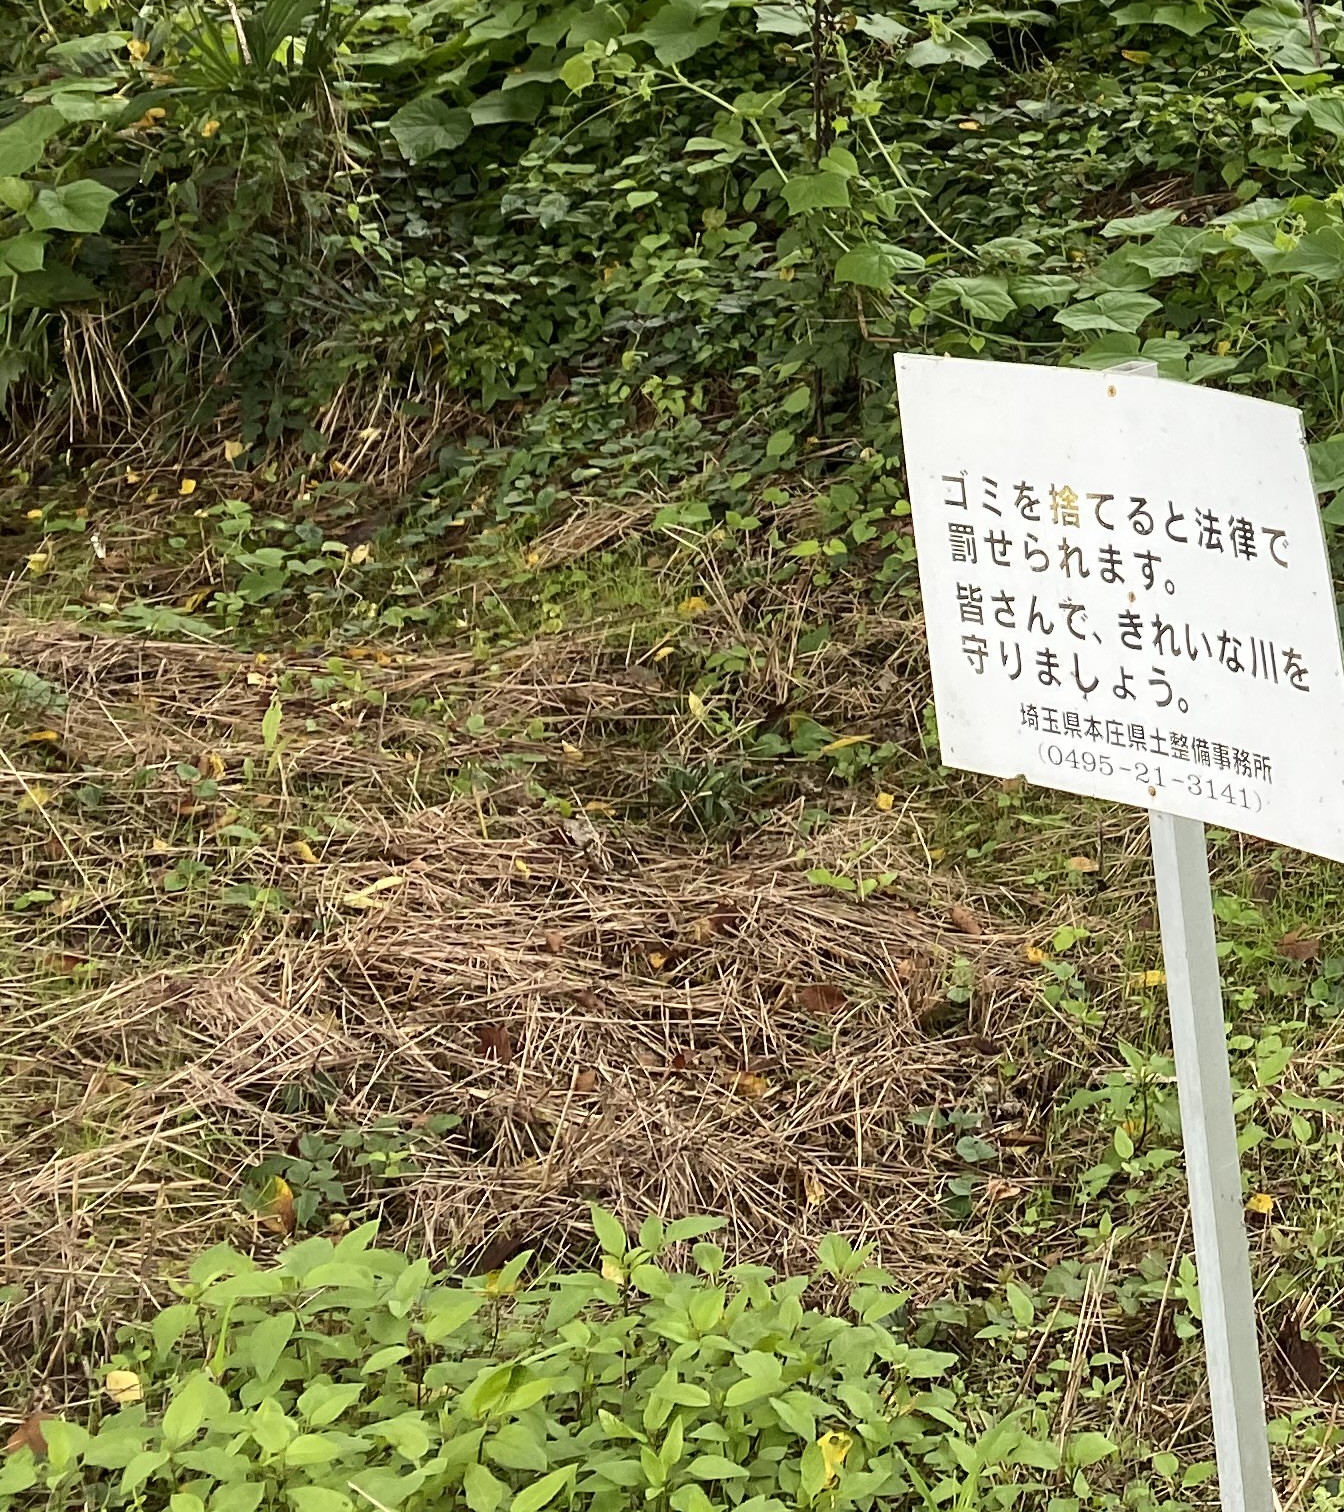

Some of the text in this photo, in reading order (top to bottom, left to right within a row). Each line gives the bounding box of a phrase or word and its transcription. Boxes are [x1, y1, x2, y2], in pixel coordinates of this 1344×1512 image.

[941, 469, 1289, 569] ゴミを捨てると法律で
[948, 522, 1175, 595] 罰せられます。
[956, 581, 1310, 692] 皆さんで、きれいな川を
[961, 634, 1189, 713] 守りましょう。
[1020, 702, 1273, 784] 埼玉県本庄県土整備事務所
[1038, 741, 1263, 812] (0495-21-3141)
